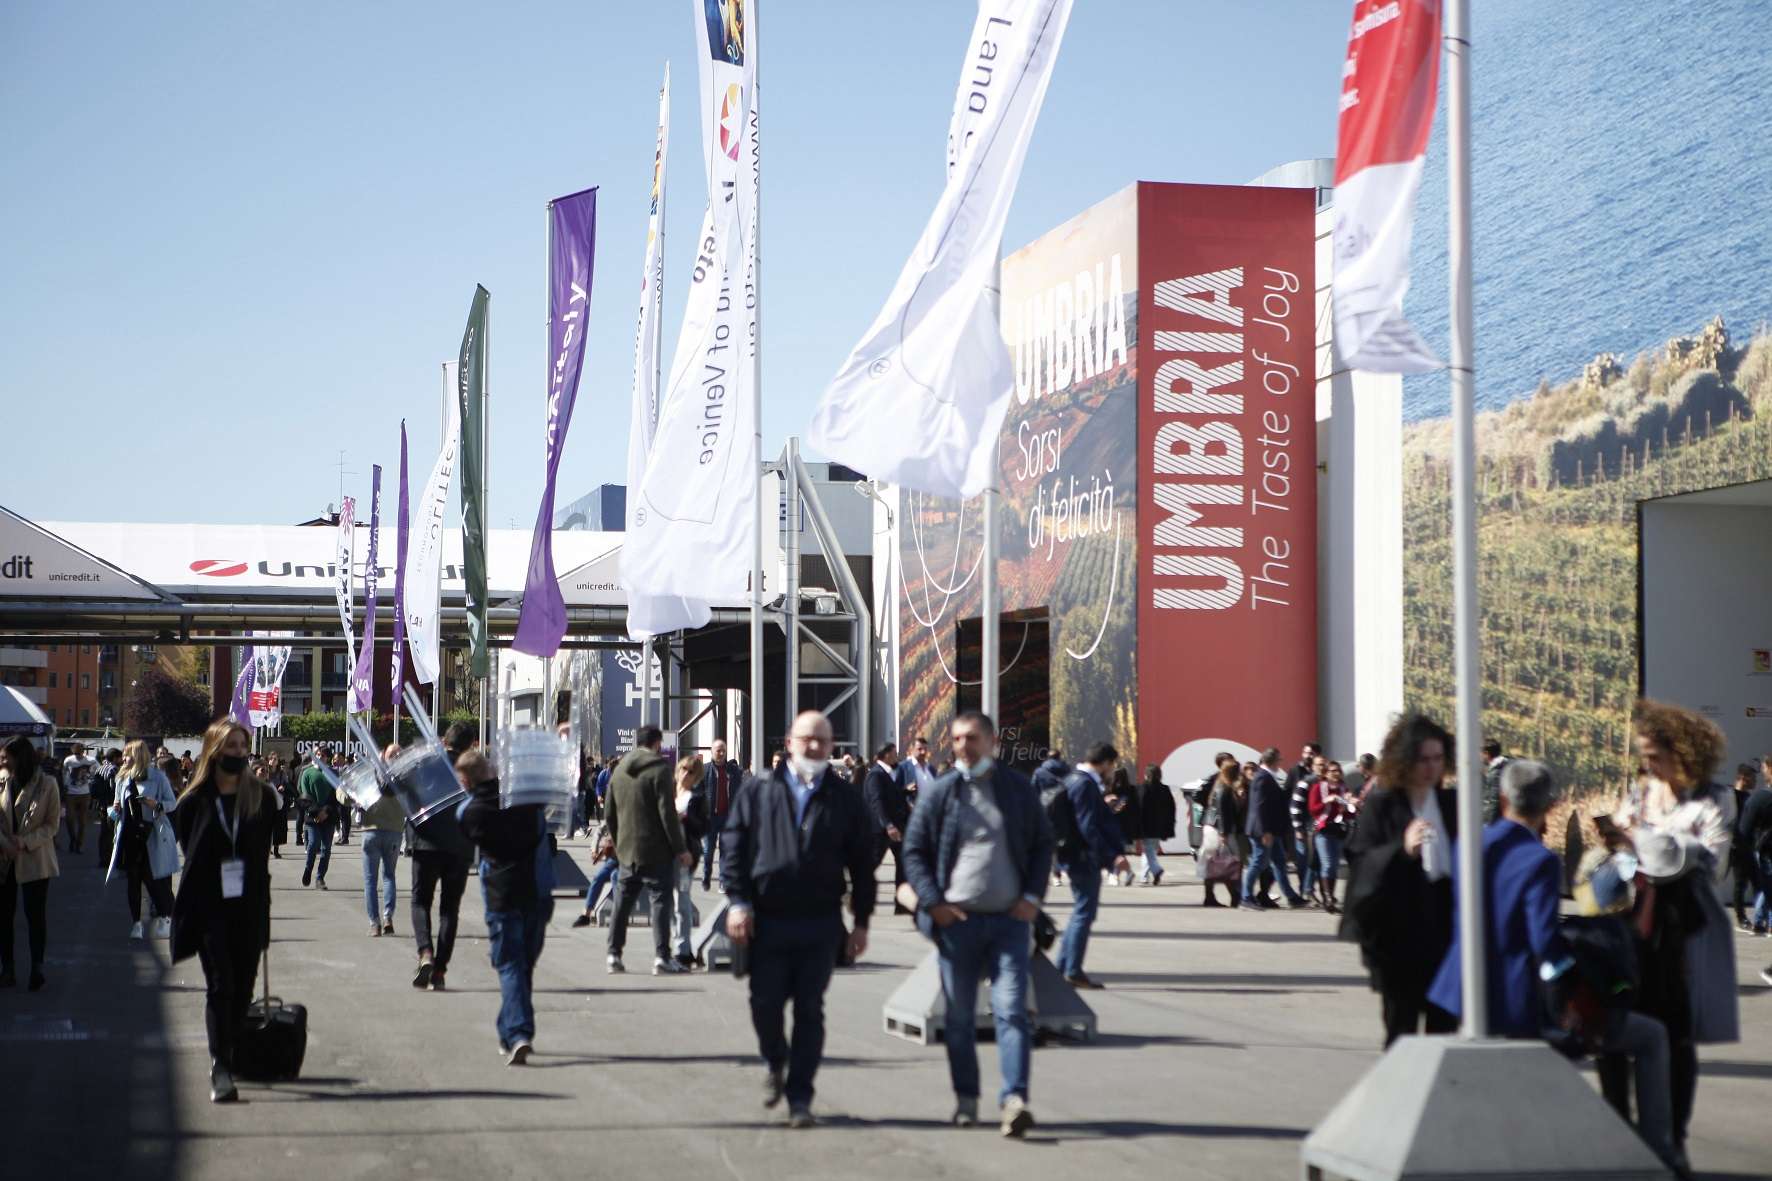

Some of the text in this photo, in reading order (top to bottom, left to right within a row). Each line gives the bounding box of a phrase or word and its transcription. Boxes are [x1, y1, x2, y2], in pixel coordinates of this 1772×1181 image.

[1015, 253, 1127, 404] UMBRIA
[1016, 412, 1062, 481] Sorsi
[1153, 266, 1244, 610] UMBRIA
[1251, 266, 1300, 610] The Taste of Joy
[1029, 469, 1114, 561] di felicità
[48, 572, 101, 582] unicredit.it
